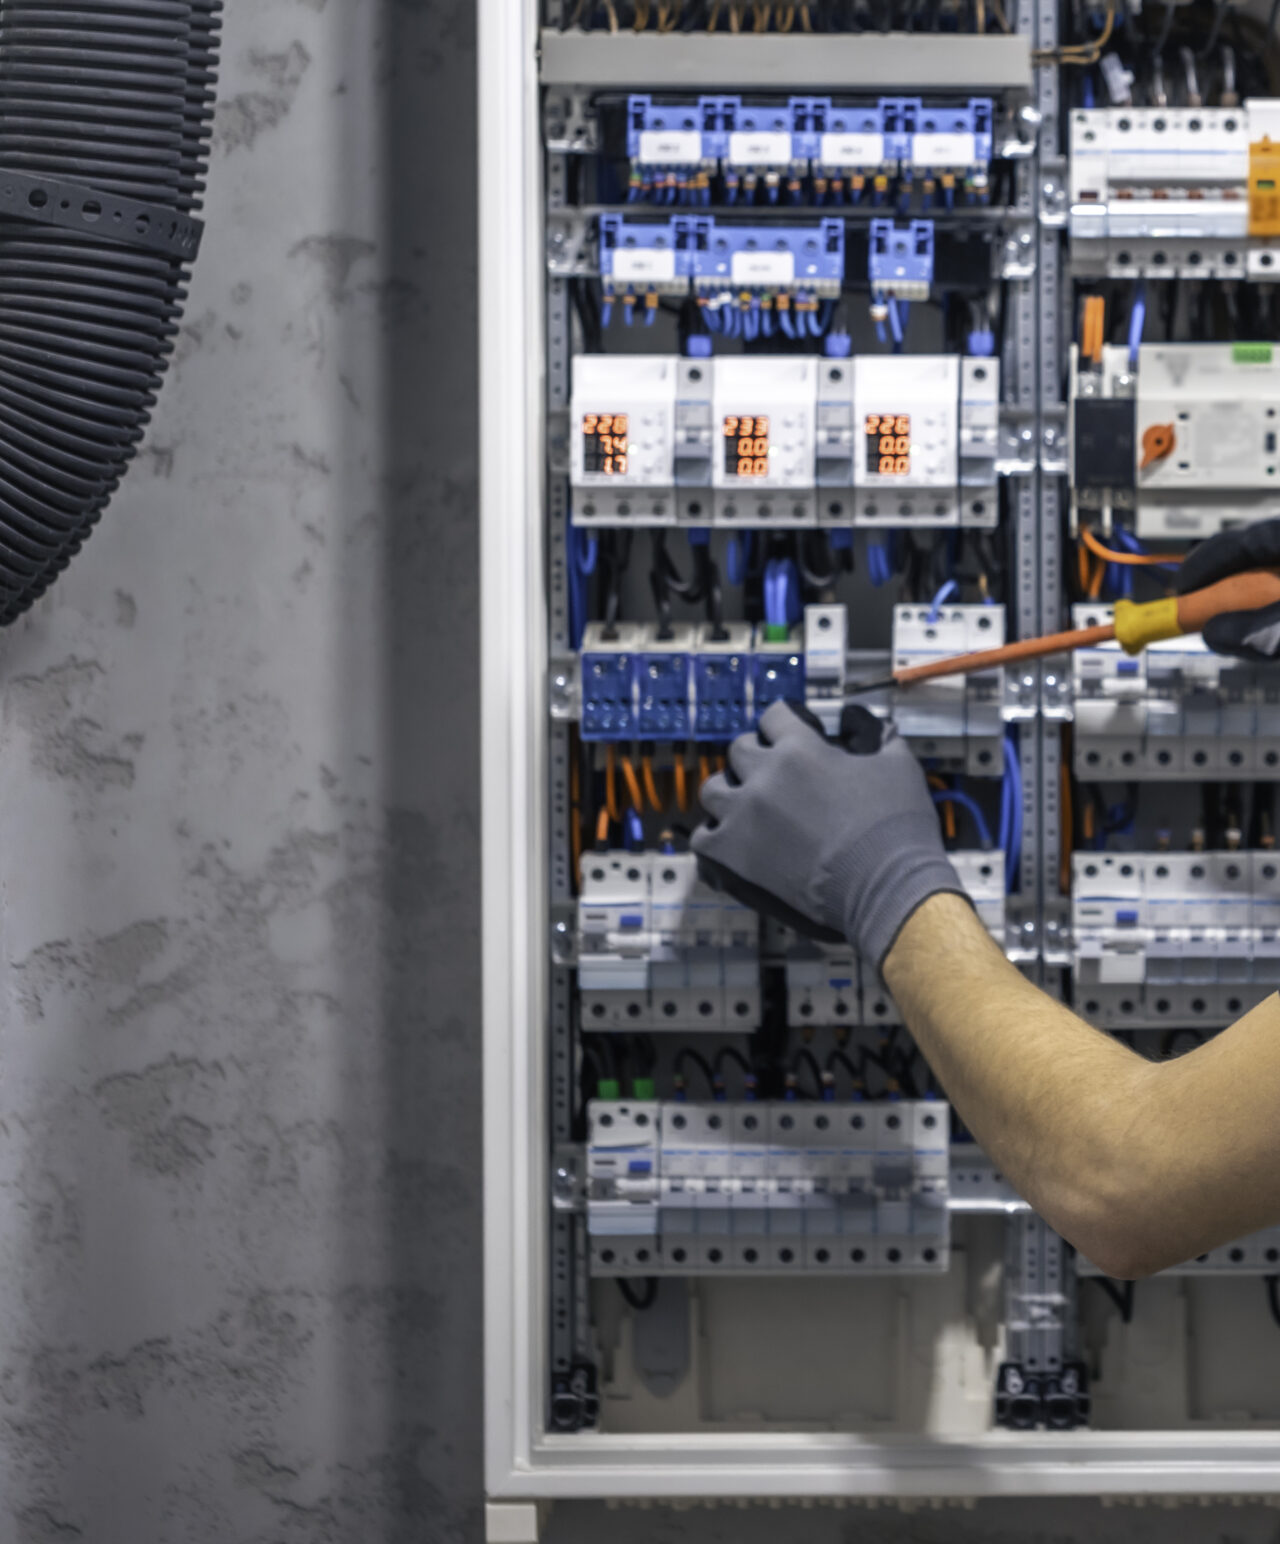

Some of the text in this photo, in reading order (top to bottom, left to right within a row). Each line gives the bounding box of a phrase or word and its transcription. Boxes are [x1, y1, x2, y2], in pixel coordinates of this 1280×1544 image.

[583, 414, 627, 434] 228
[723, 416, 768, 436] 233
[864, 414, 910, 434] 226
